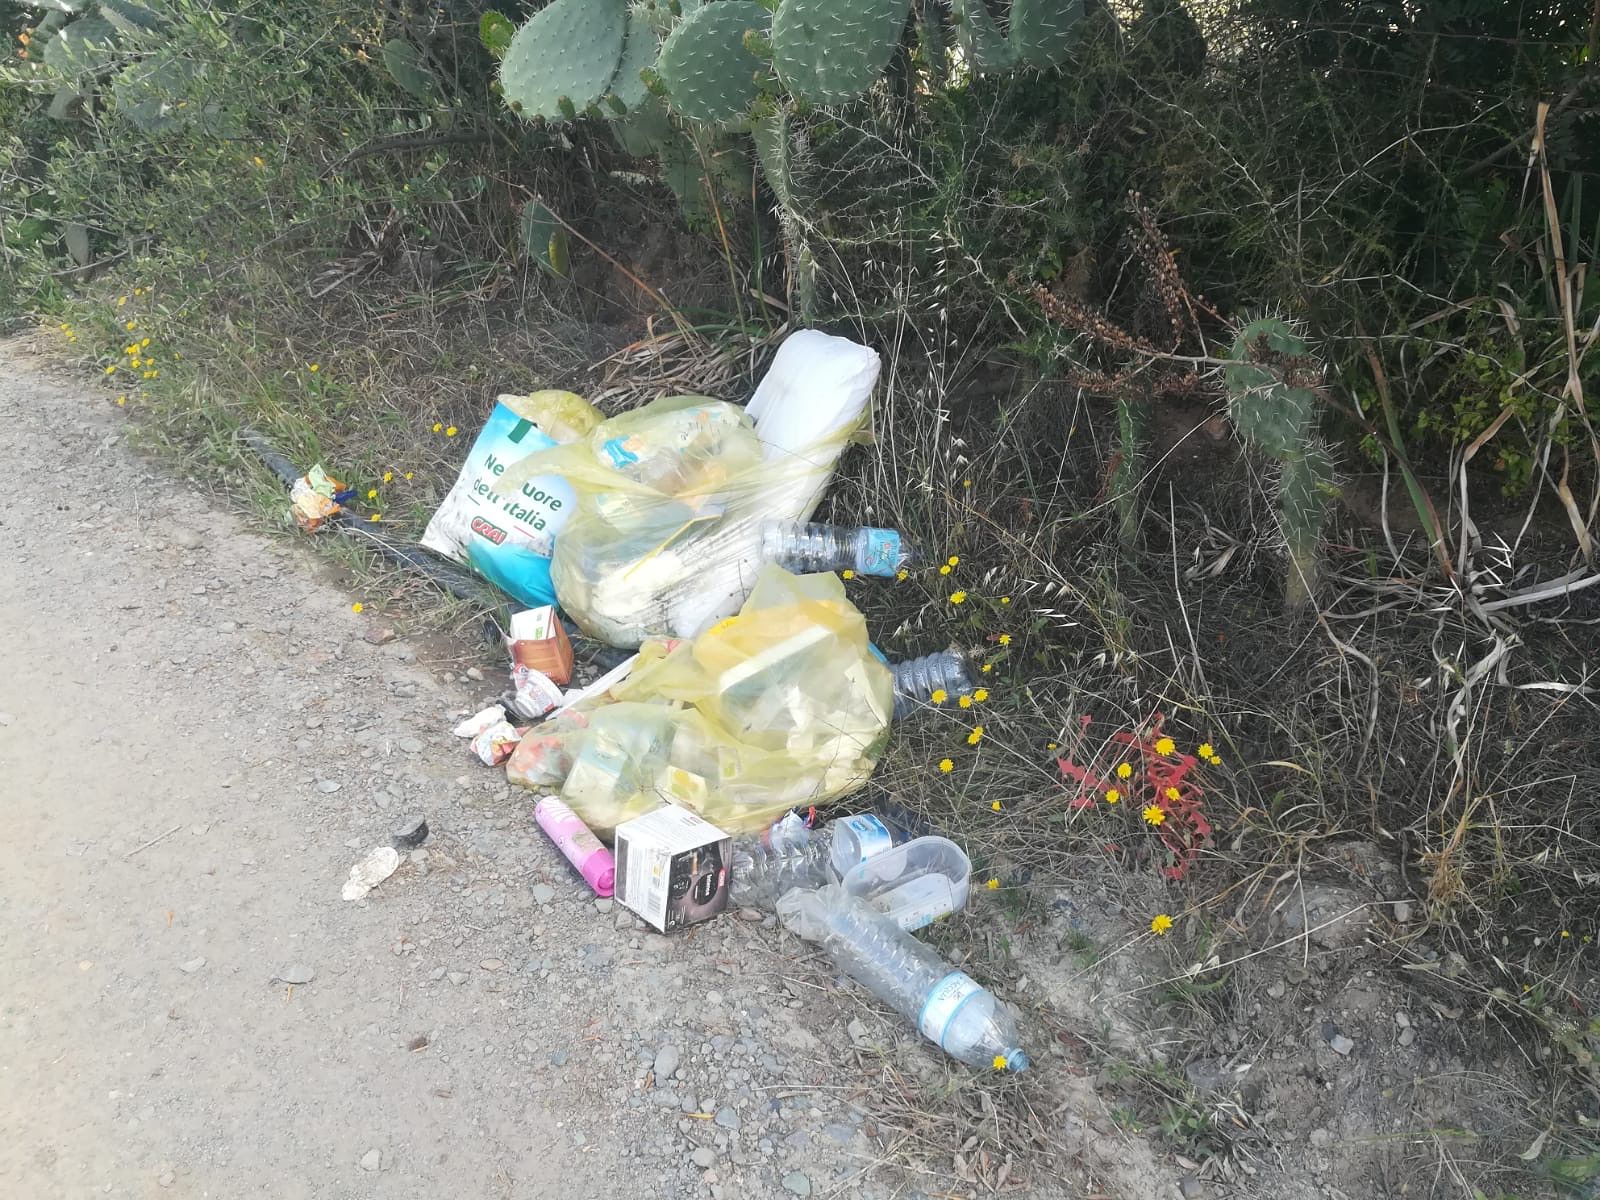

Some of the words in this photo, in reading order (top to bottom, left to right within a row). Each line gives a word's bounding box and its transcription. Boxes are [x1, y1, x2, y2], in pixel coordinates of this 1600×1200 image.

[484, 454, 505, 476] Ne
[522, 482, 563, 512] uore
[471, 515, 508, 545] CRAI
